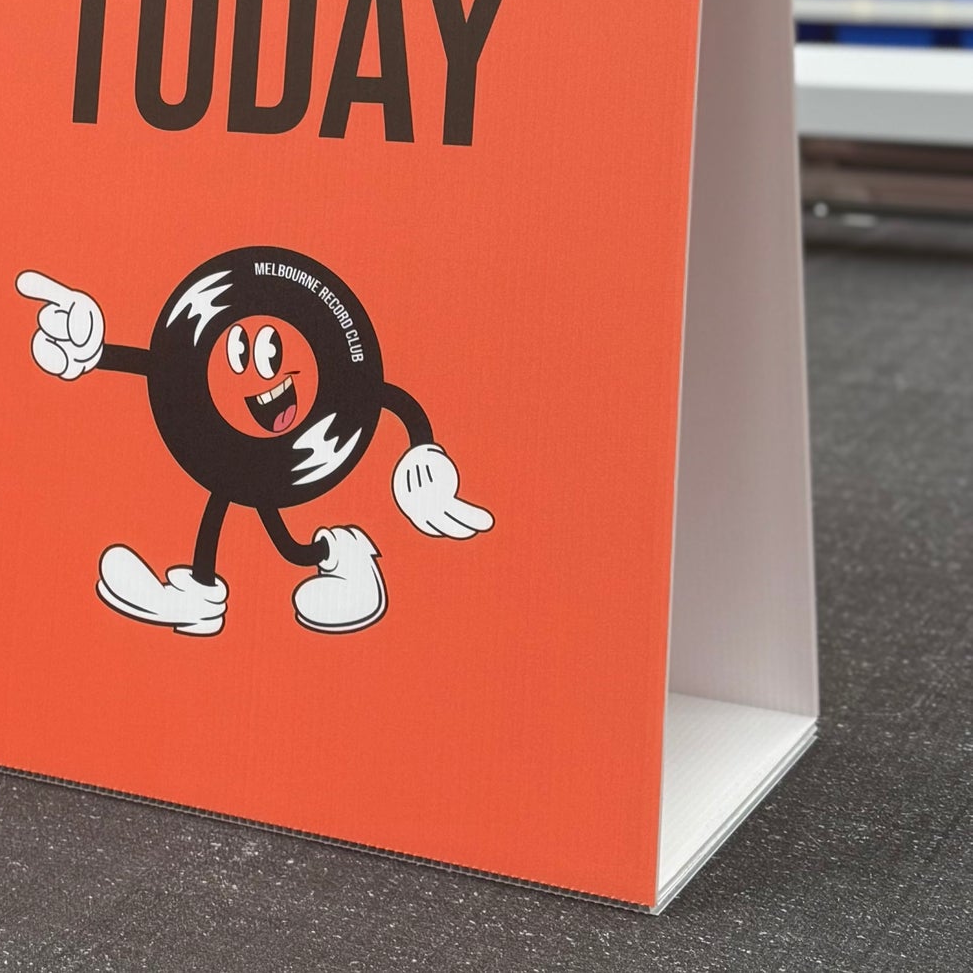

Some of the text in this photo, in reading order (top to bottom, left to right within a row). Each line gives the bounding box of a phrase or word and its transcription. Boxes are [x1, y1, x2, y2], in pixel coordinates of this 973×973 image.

[254, 262, 364, 363] MELBOURNE RECORD CLUB
